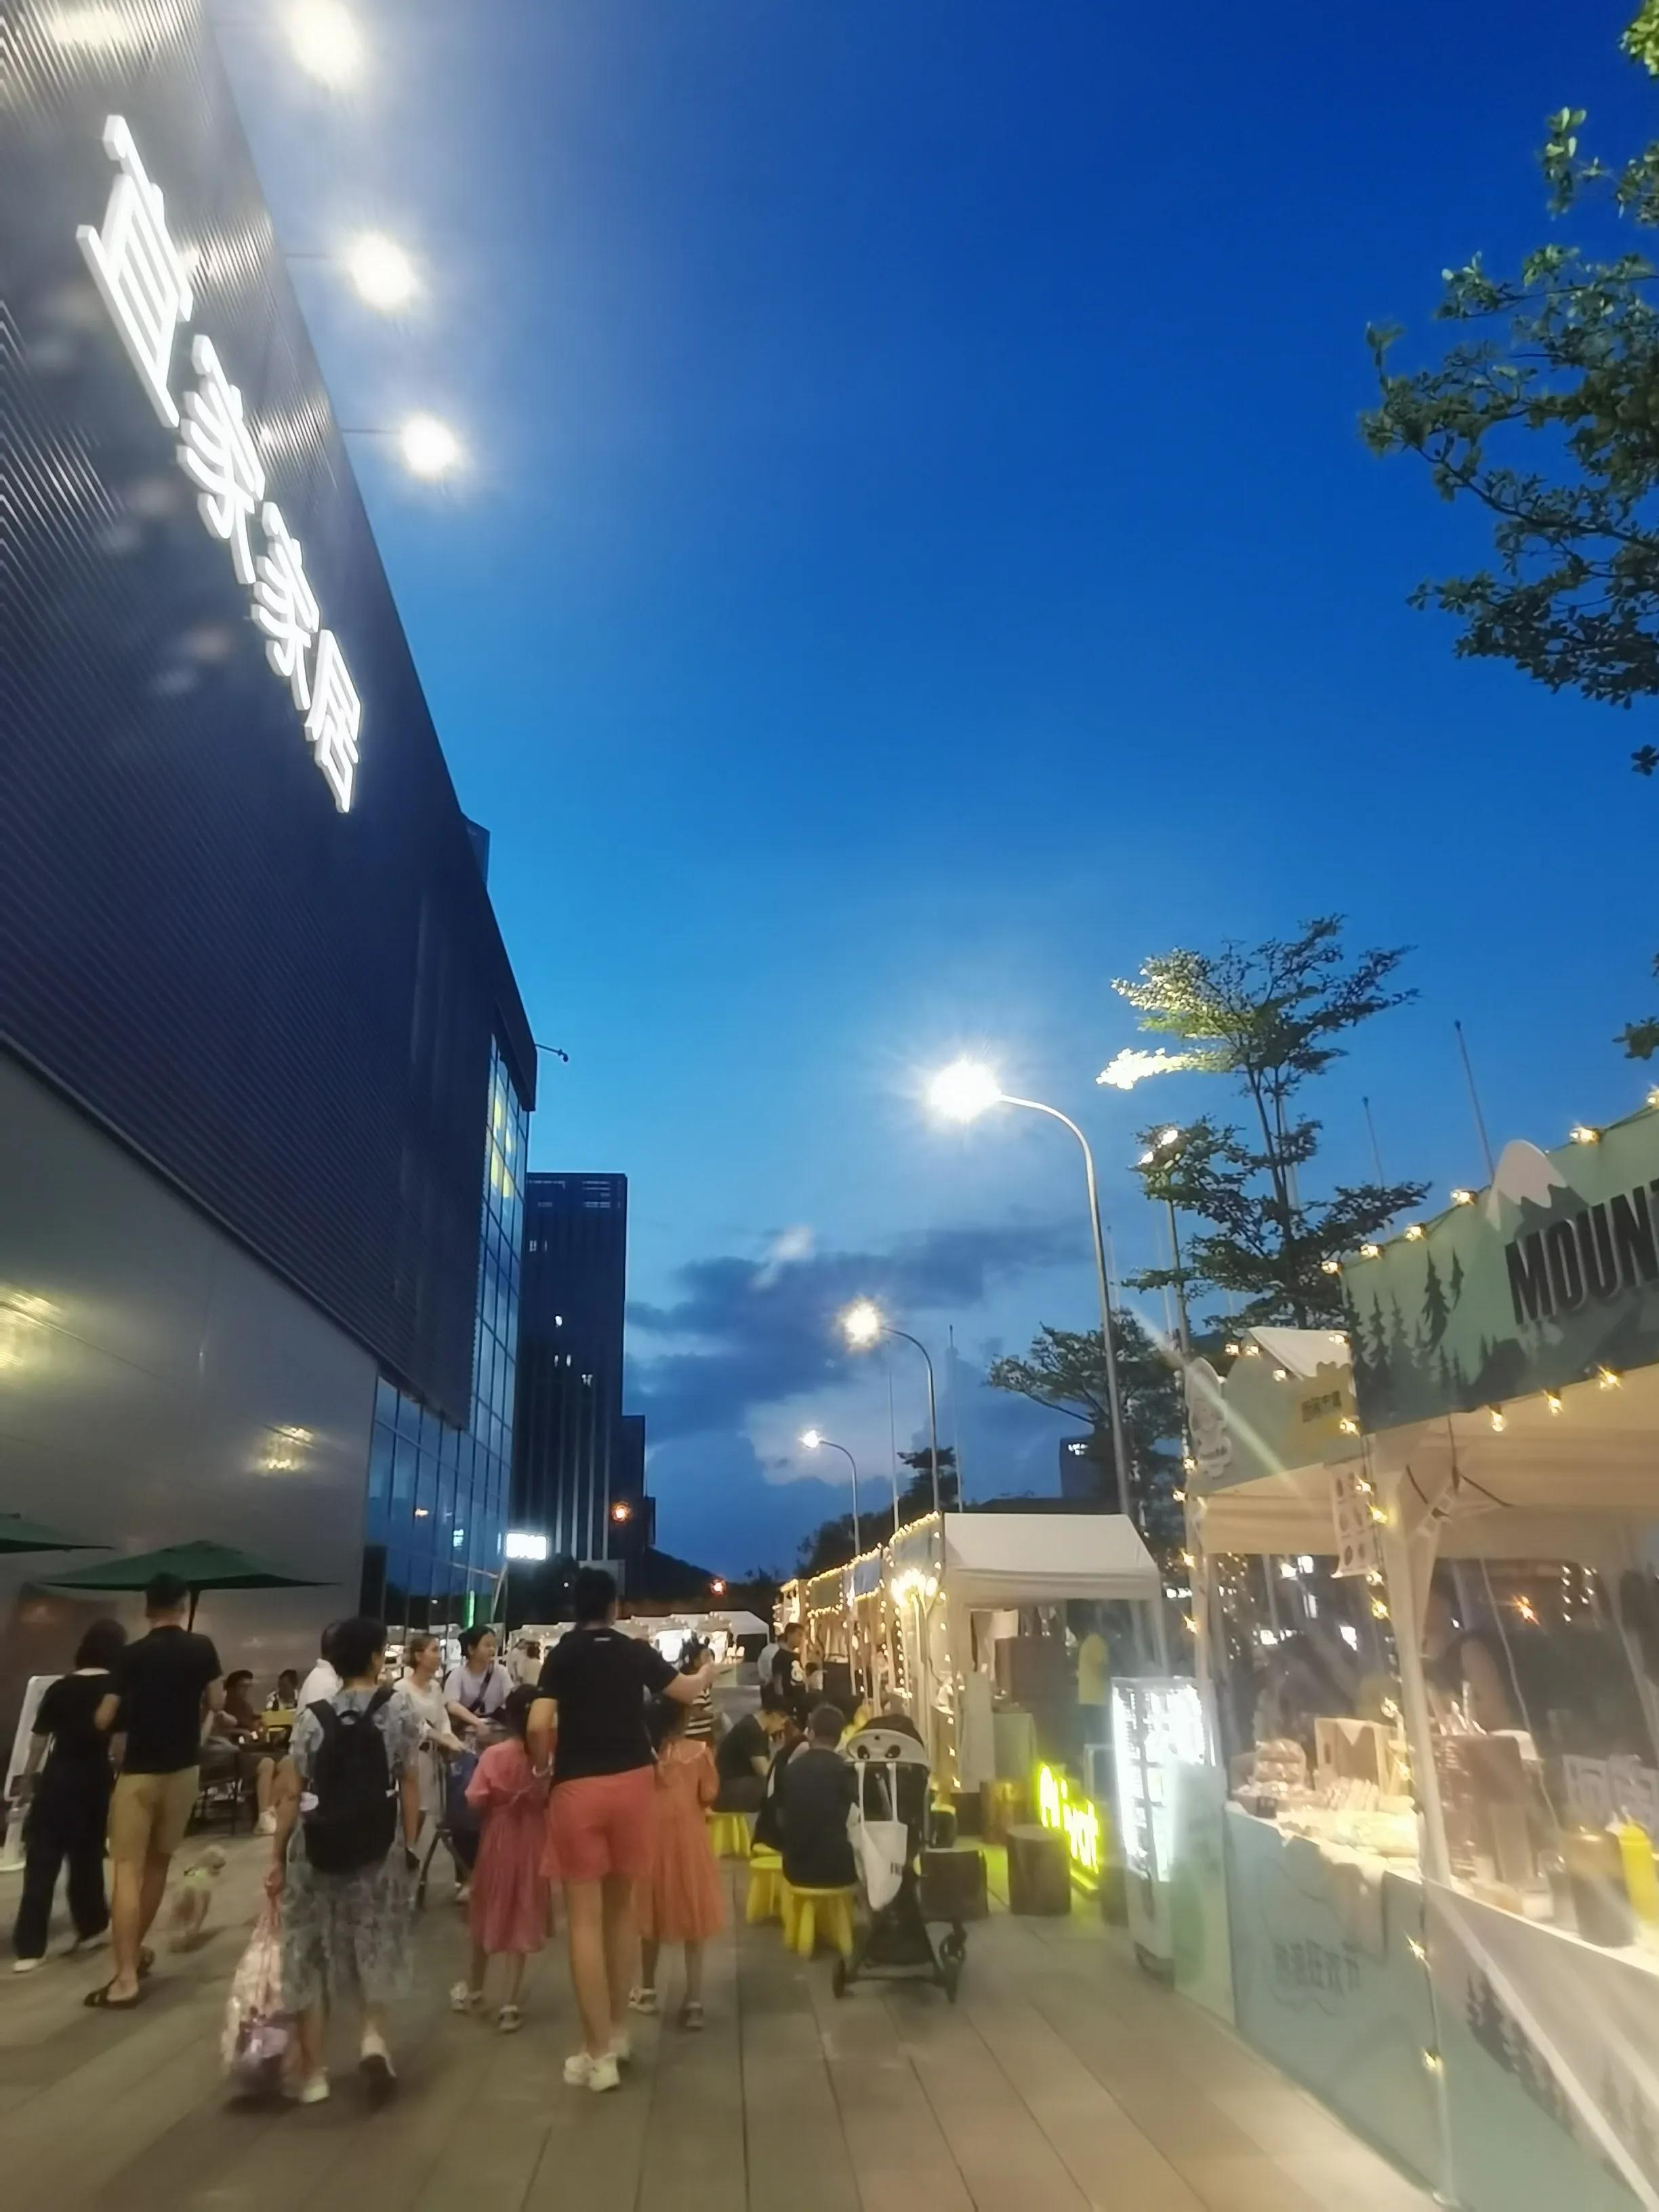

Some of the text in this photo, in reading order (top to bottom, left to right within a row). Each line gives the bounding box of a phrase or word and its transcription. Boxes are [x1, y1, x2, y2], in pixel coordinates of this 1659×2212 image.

[76, 114, 362, 813] 宜家家居
[1505, 1178, 1659, 1325] MOUN
